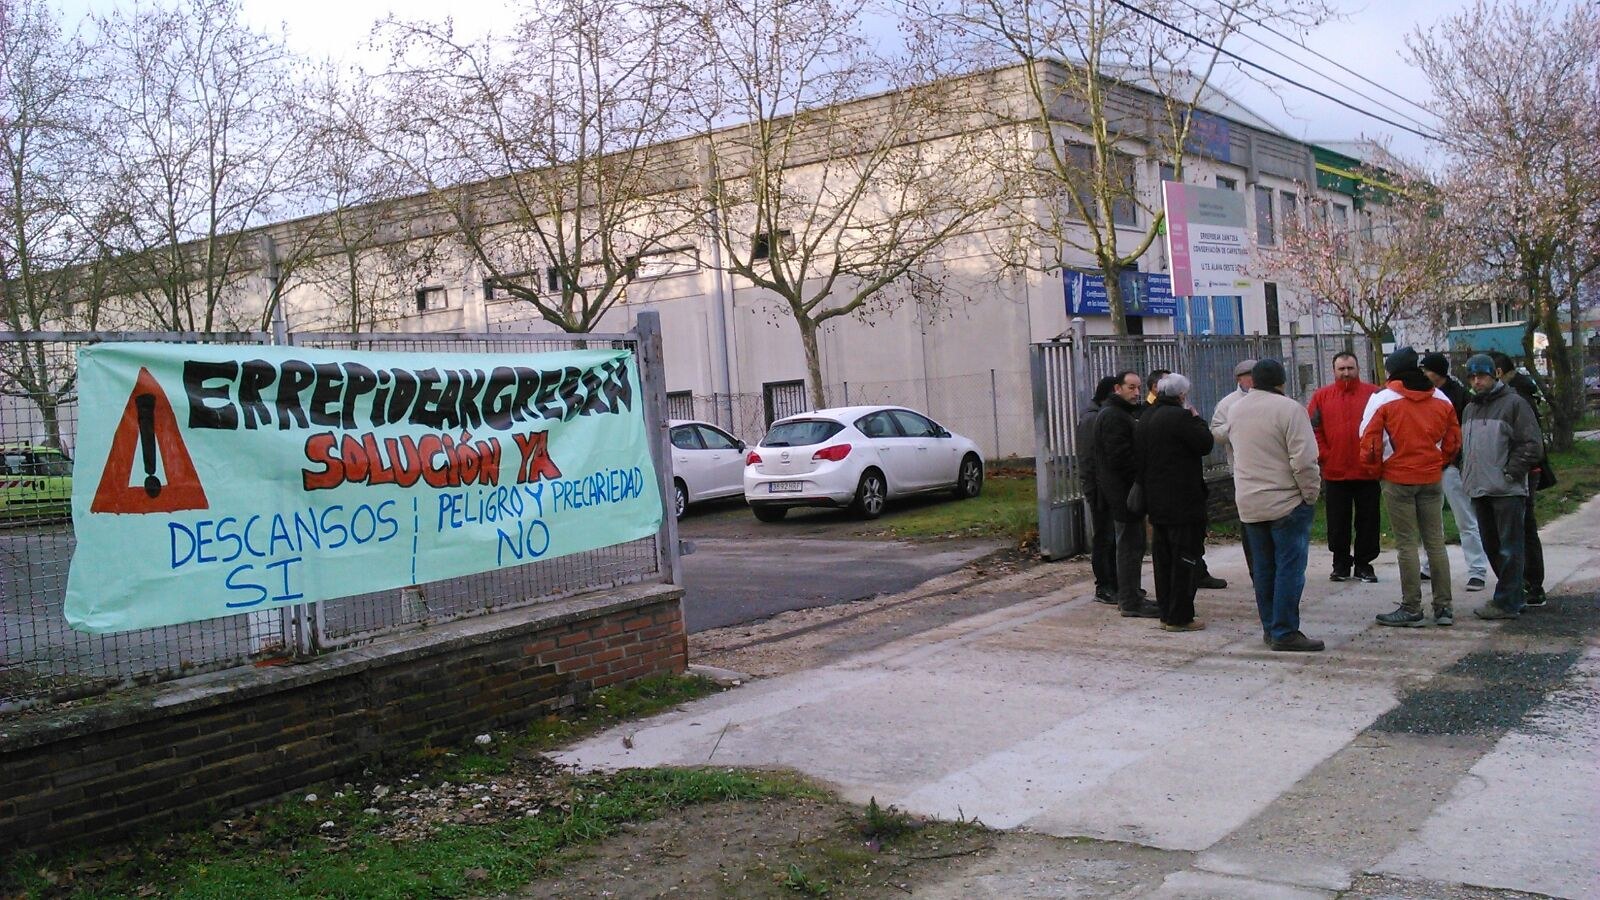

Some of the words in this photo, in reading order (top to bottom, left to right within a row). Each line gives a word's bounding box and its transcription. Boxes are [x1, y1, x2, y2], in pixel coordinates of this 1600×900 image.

[513, 430, 563, 485] YA
[524, 483, 544, 518] Y
[168, 500, 398, 569] DESCANSOS
[497, 519, 550, 567] NO
[225, 557, 304, 608] SI
